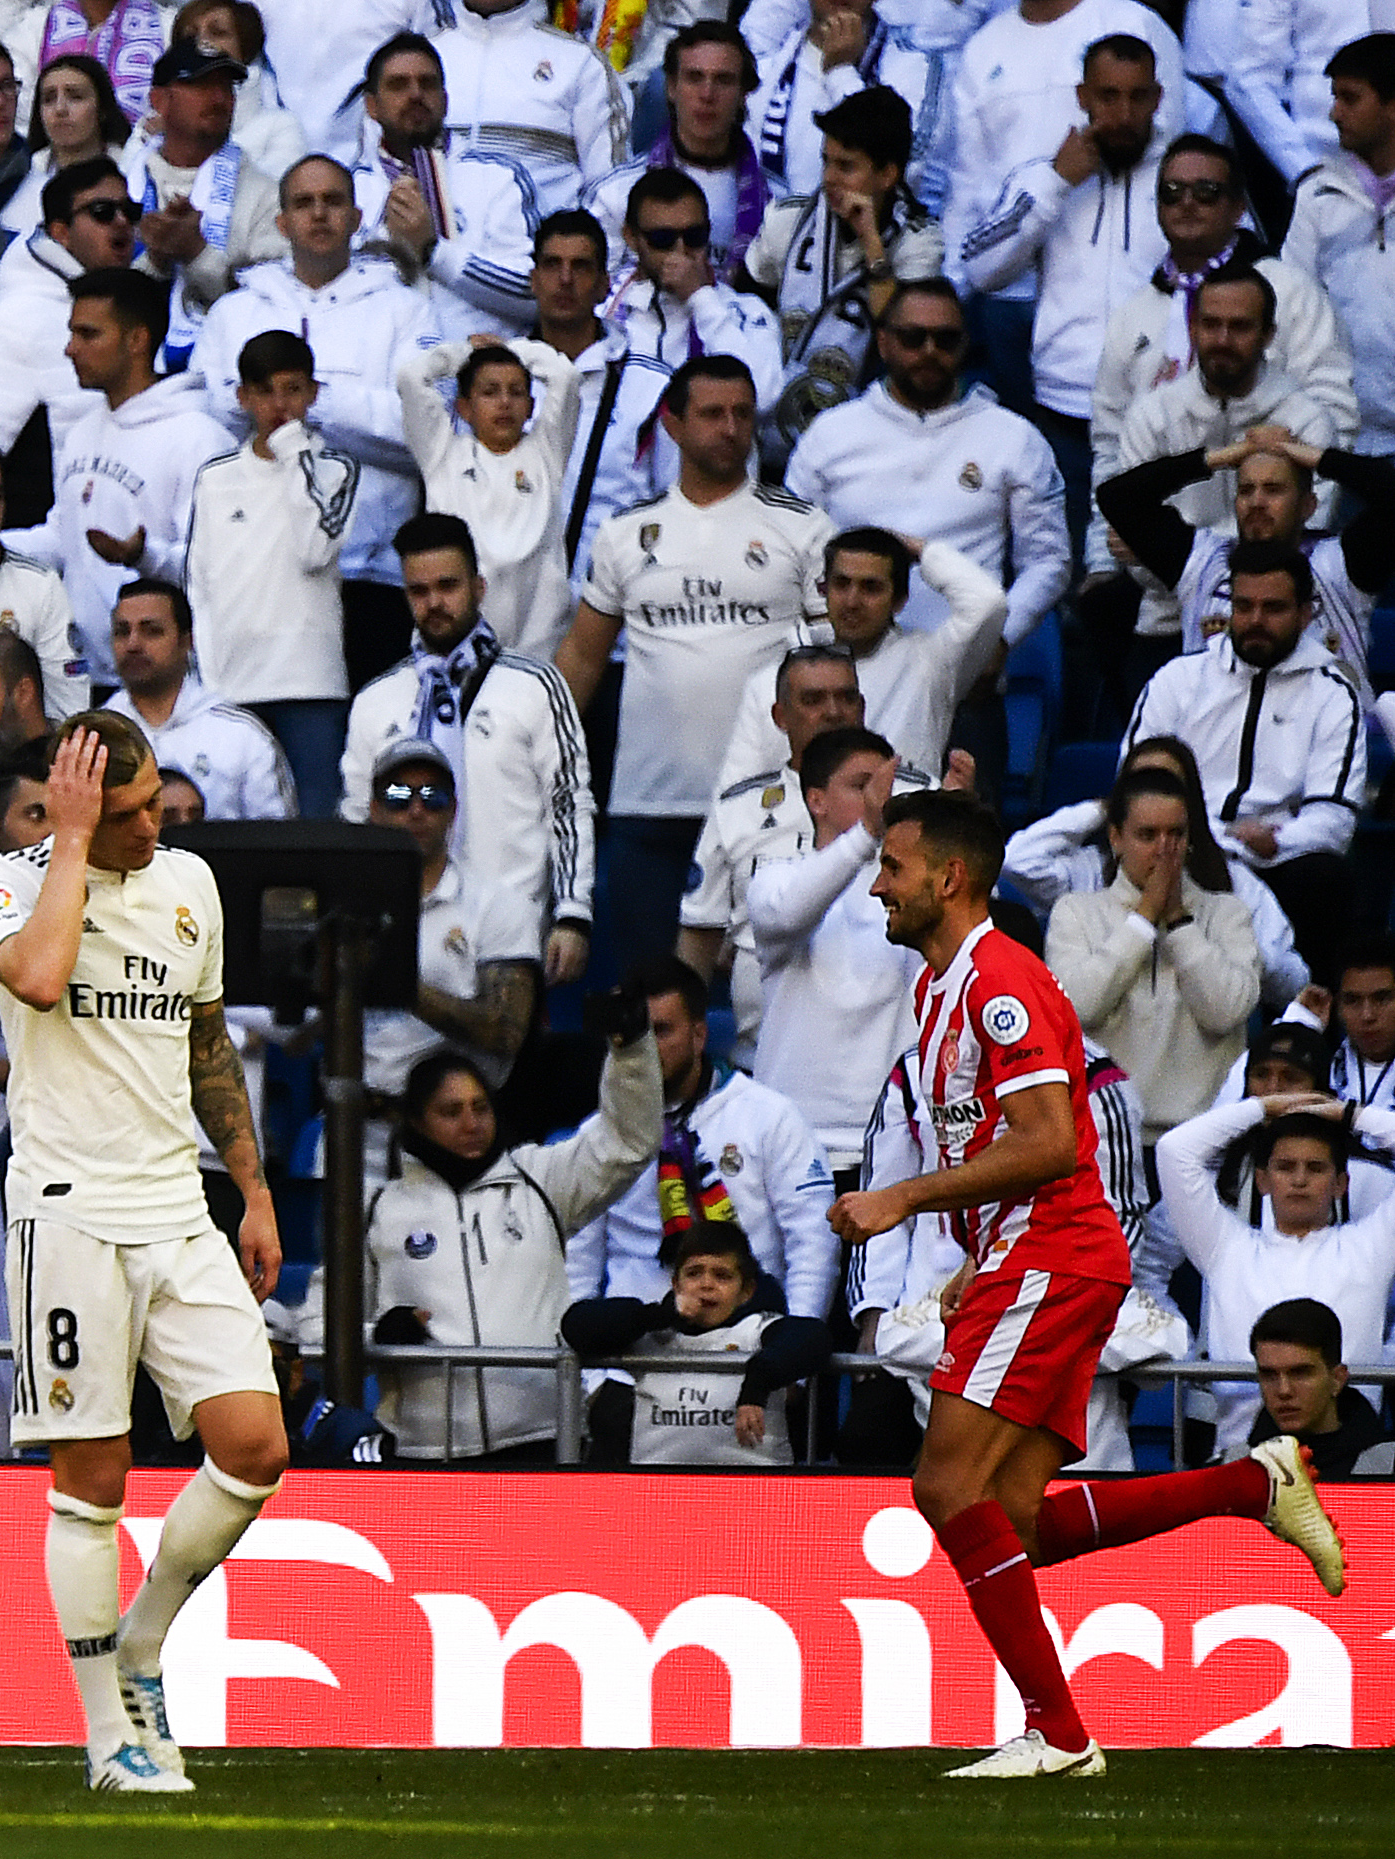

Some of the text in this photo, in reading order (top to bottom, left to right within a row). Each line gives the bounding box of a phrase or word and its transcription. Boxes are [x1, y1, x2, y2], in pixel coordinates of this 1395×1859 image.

[123, 955, 168, 987] Fly
[70, 983, 193, 1022] Emirate
[46, 1307, 80, 1371] 8
[678, 1386, 709, 1405] Fly
[650, 1404, 736, 1427] Emirate
[120, 1506, 1395, 1750] Emira
